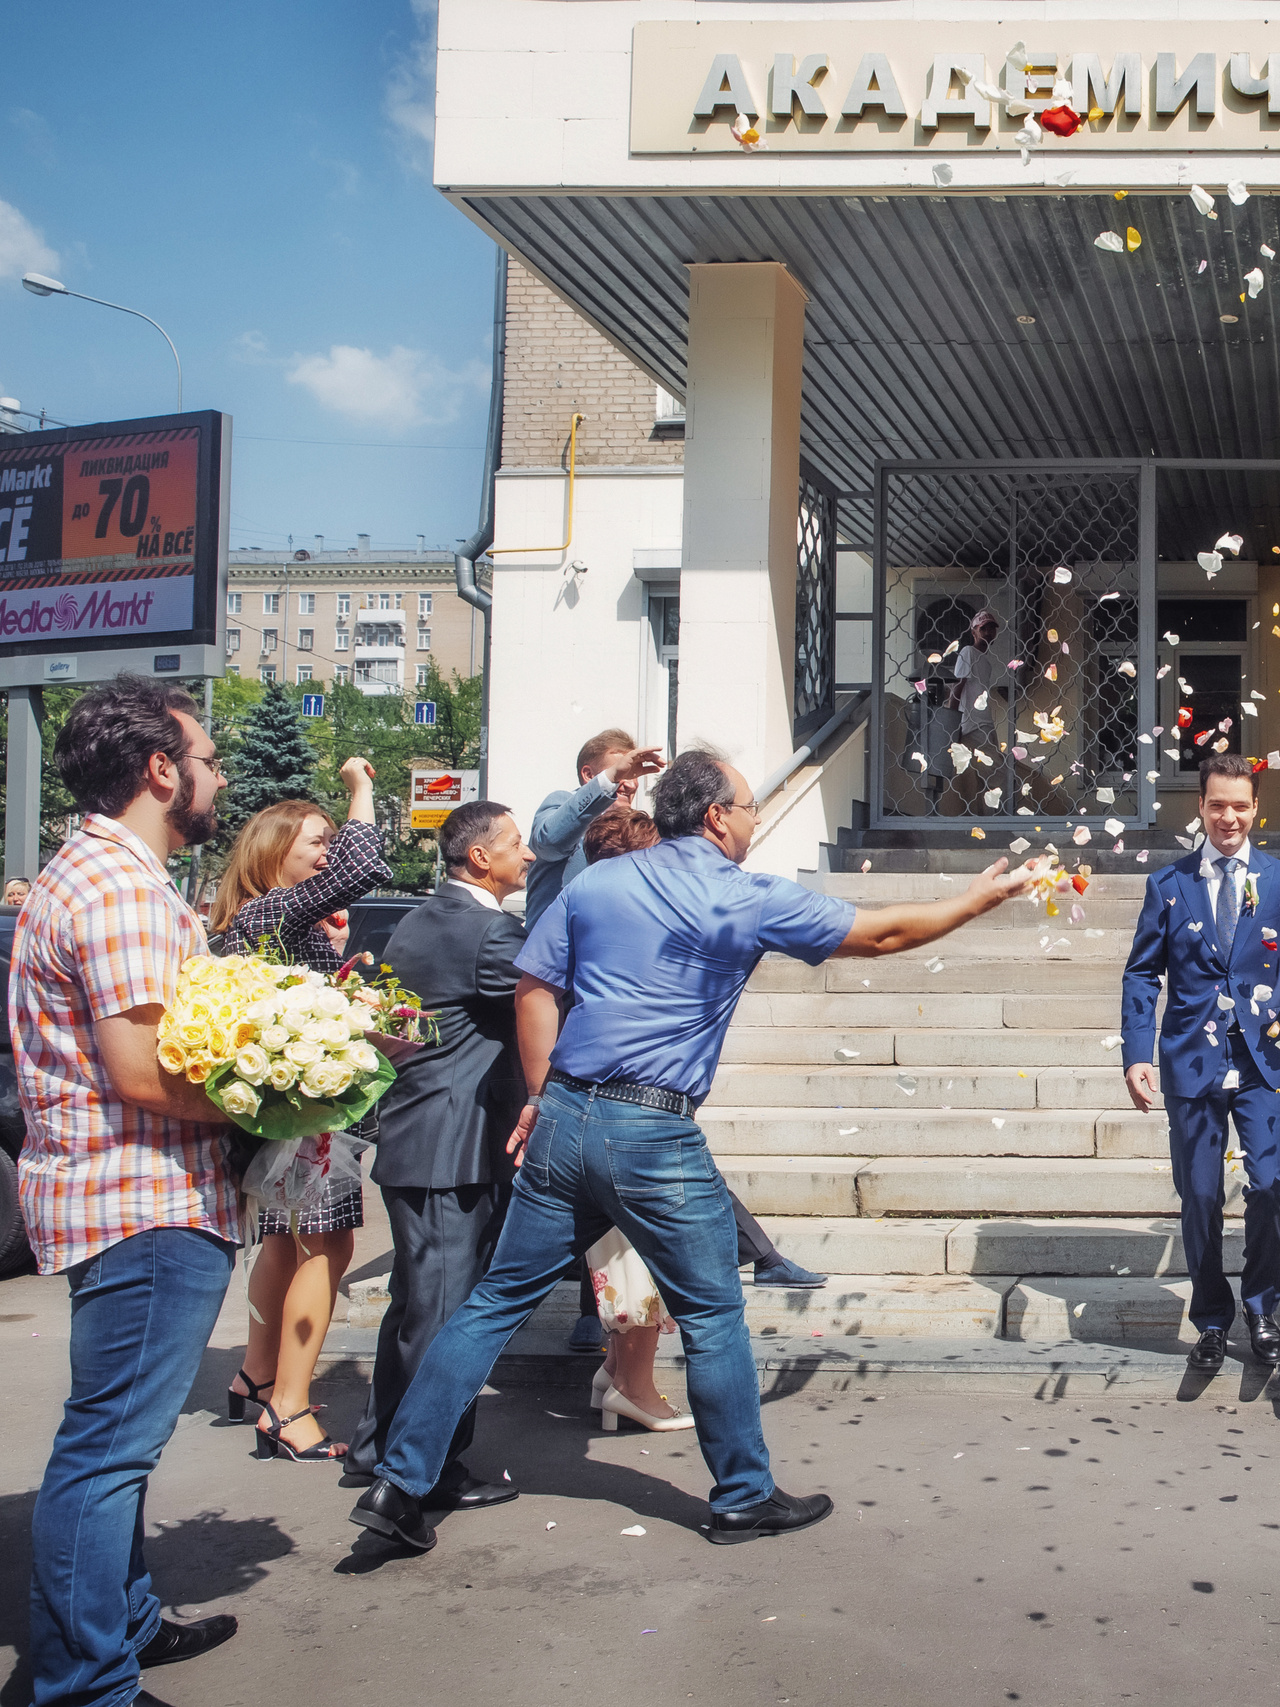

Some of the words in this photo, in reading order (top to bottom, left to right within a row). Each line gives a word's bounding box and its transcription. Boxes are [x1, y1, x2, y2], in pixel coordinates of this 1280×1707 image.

[80, 451, 169, 477] ЛИКВИДАЦИЯ
[136, 533, 160, 558] НА
[162, 526, 195, 556] ВСЁ
[50, 662, 70, 673] Gallery
